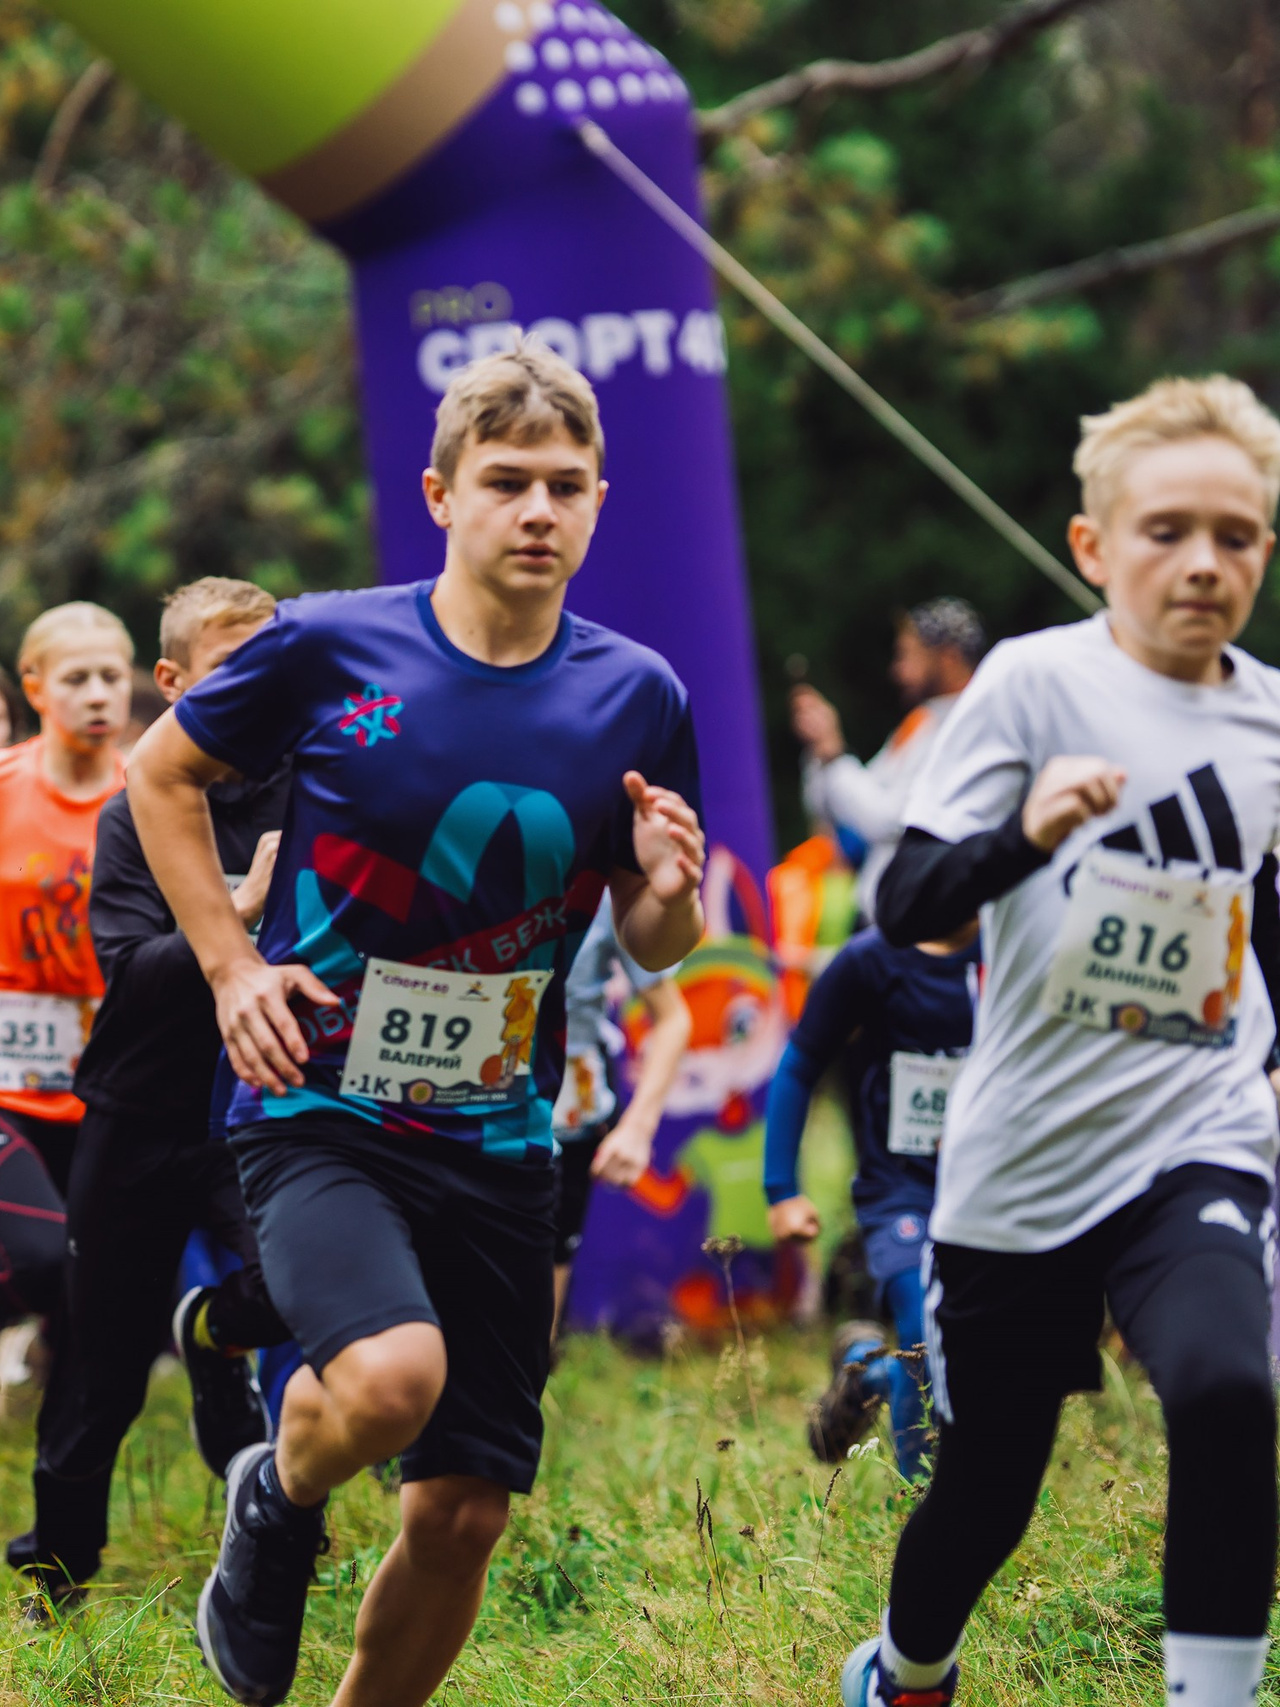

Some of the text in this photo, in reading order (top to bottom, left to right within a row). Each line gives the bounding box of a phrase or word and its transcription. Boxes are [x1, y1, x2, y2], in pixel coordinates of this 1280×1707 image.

[1092, 915, 1190, 973] 816
[0, 1020, 56, 1047] 351
[381, 1008, 472, 1051] 819
[379, 1048, 462, 1070] ВАЛЕРИЙ
